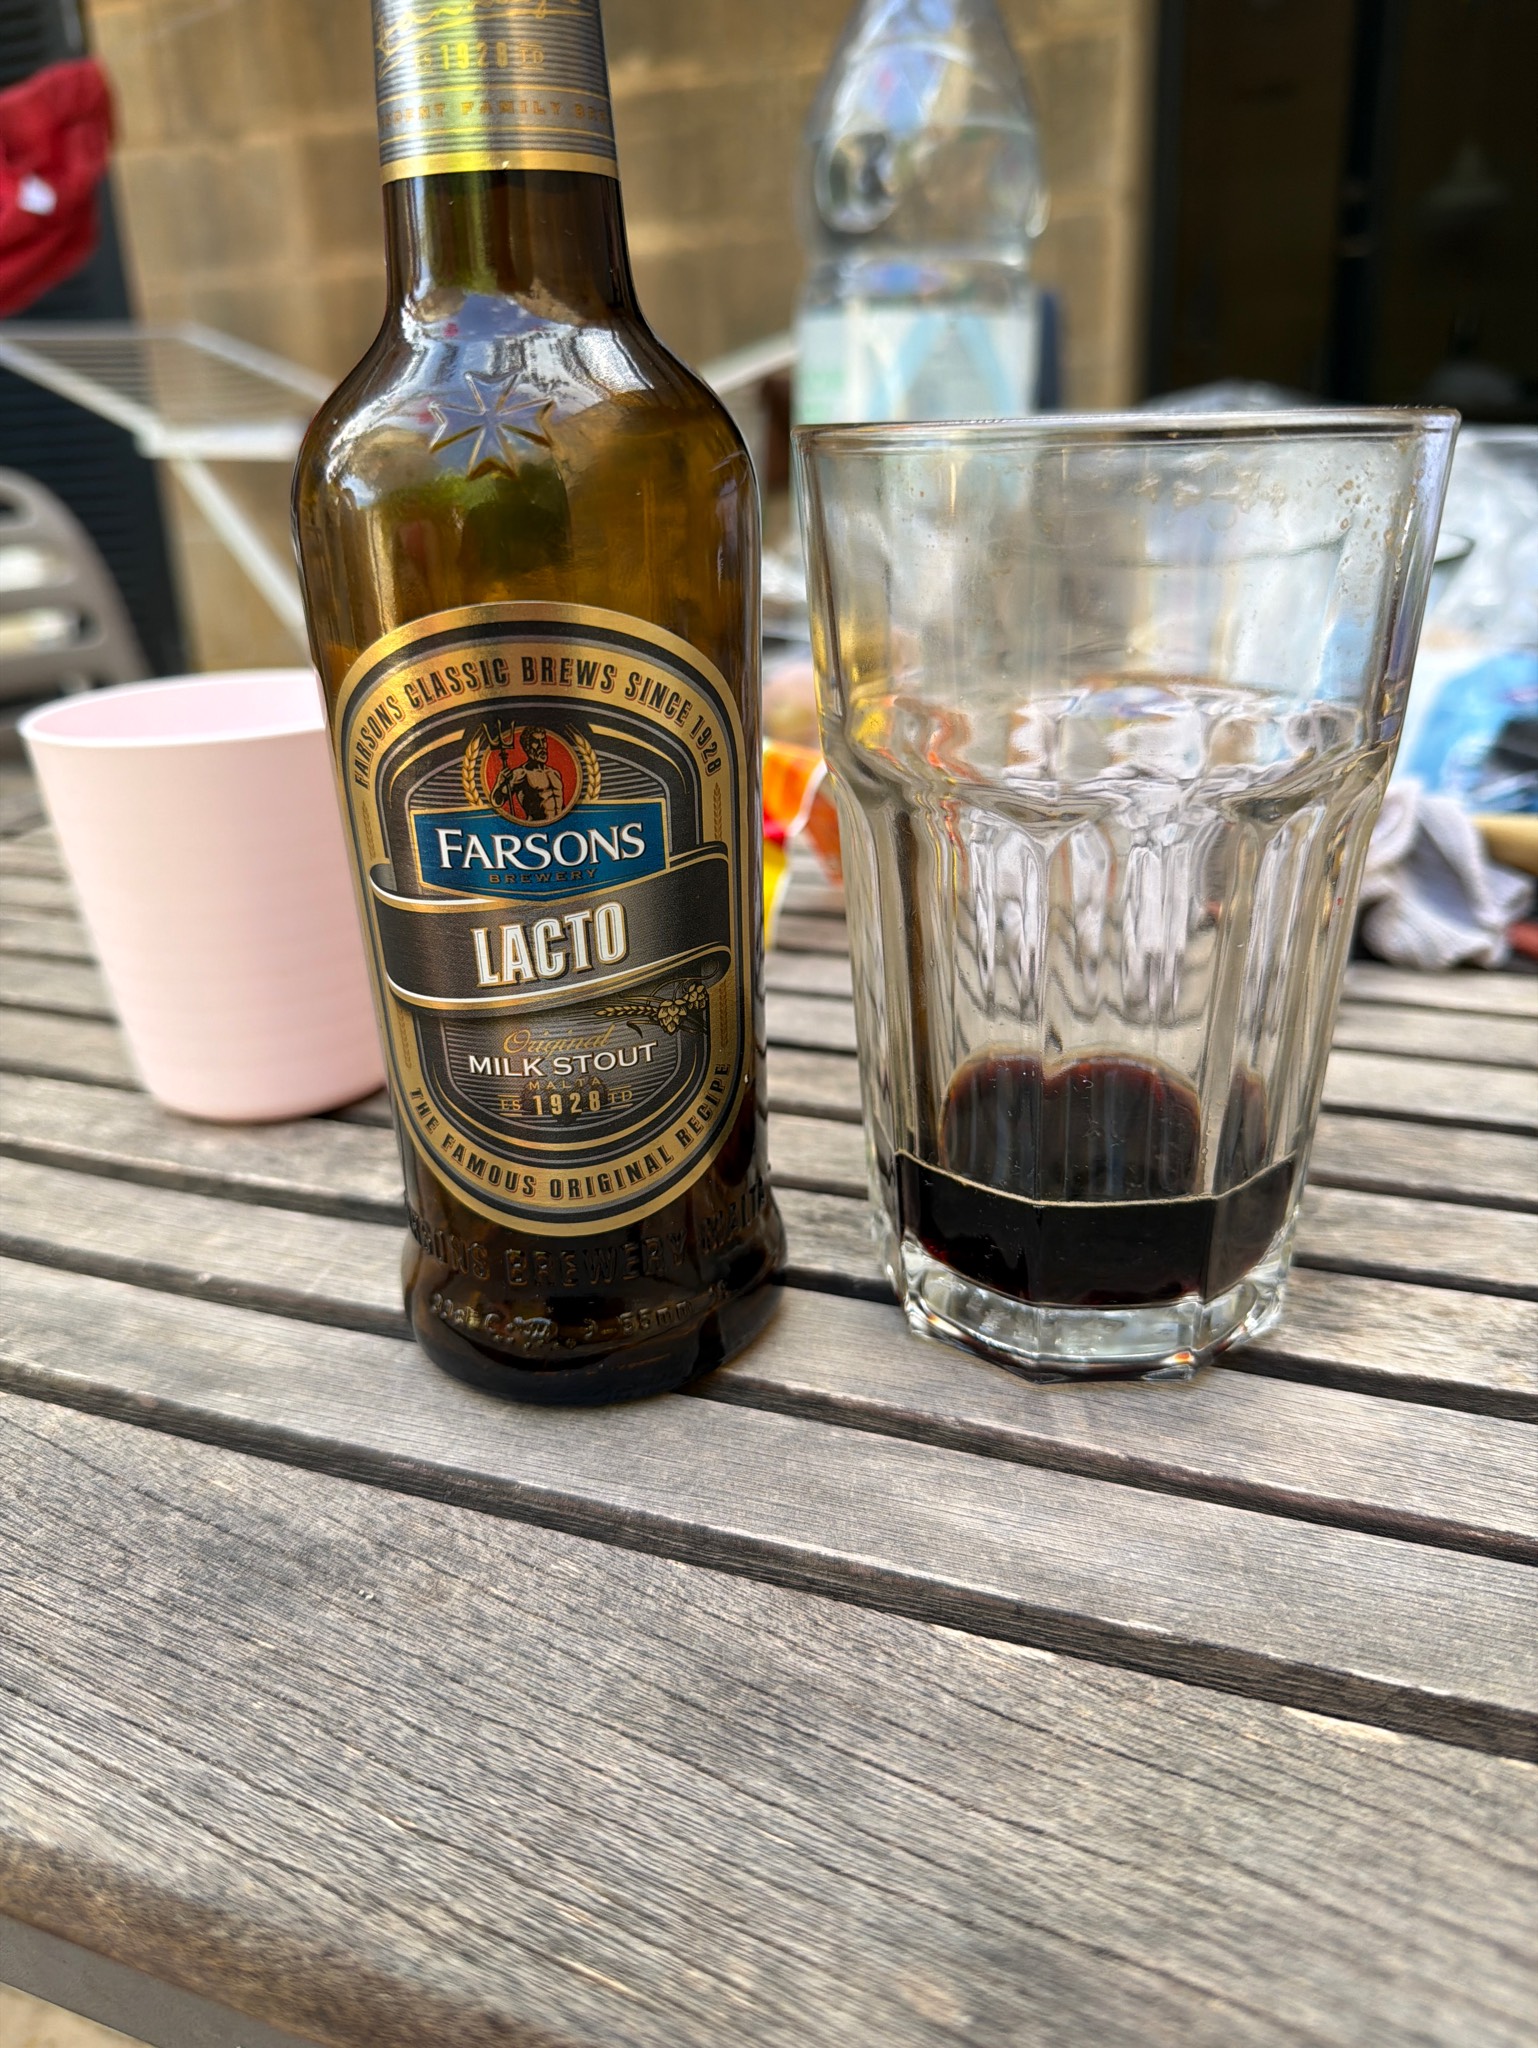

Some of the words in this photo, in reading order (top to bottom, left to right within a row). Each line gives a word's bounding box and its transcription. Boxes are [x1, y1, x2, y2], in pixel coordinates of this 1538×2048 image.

[441, 41, 508, 70] 1928
[461, 100, 560, 116] FAMILY
[354, 693, 405, 789] FARSONS
[404, 656, 510, 708] CLASSIC
[521, 655, 618, 693] BREWS
[624, 671, 694, 729] SINCE
[688, 714, 724, 779] 1928
[434, 821, 647, 871] FARSONS
[488, 868, 598, 885] BREWERY
[470, 900, 628, 988] LACTO
[503, 1021, 617, 1059] Original
[468, 1053, 546, 1079] MILK
[552, 1040, 659, 1077] STOUT
[500, 1099, 522, 1112] ES
[533, 1089, 601, 1116] 1928
[608, 1089, 633, 1105] TD
[528, 1076, 603, 1091] MALTA
[409, 1085, 440, 1133] THE
[441, 1132, 538, 1199] FAMOUS
[549, 1143, 675, 1201] ORIGINAL
[675, 1062, 732, 1150] RECIPE
[506, 1228, 687, 1287] BREWERY
